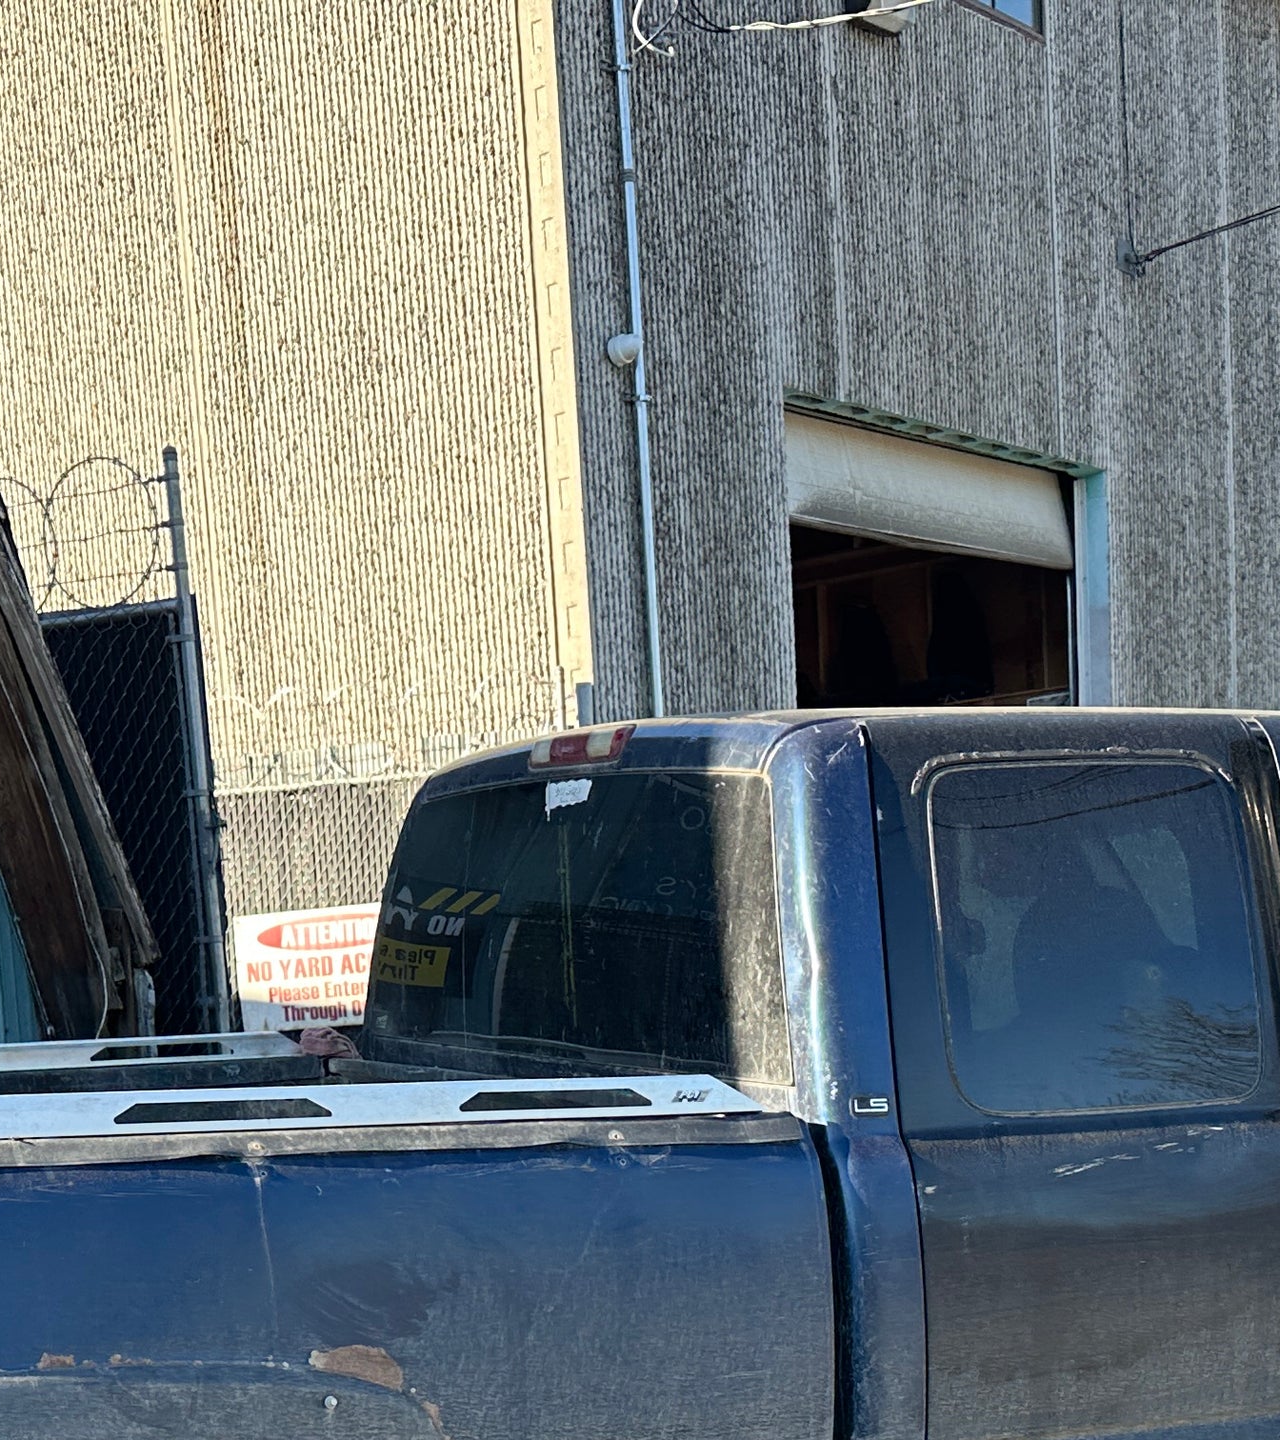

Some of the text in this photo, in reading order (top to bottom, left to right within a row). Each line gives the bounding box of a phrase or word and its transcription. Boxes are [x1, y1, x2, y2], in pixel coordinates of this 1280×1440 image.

[246, 961, 273, 984] NO
[279, 955, 334, 981] YARD
[268, 981, 365, 1003] Please Enter
[282, 1001, 348, 1023] Through
[853, 1097, 889, 1113] LS
